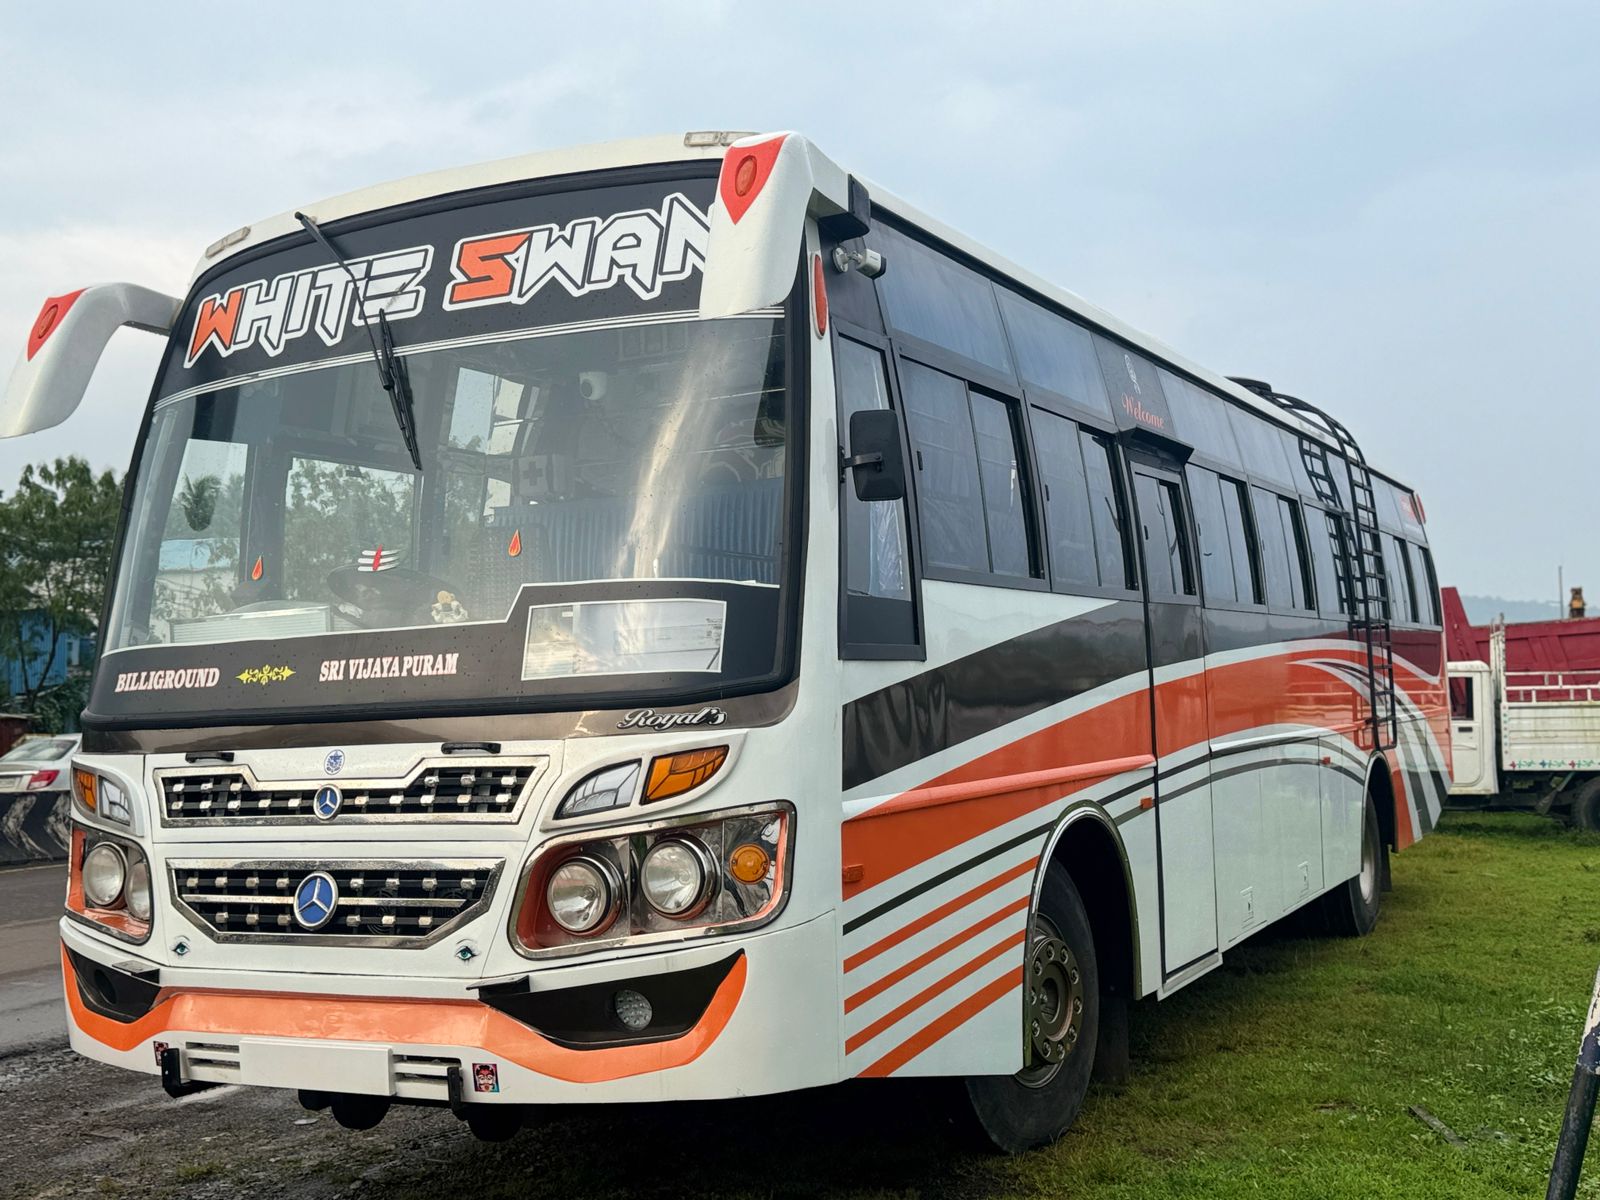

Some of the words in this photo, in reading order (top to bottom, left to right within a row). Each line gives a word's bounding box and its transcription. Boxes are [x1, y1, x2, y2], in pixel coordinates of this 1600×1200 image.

[184, 245, 434, 368] WHITE
[443, 192, 714, 313] SWAN
[1121, 392, 1164, 428] Welcome
[114, 667, 221, 693] BILLIGROUND
[319, 659, 346, 682] SRI
[617, 706, 728, 731] Royal's
